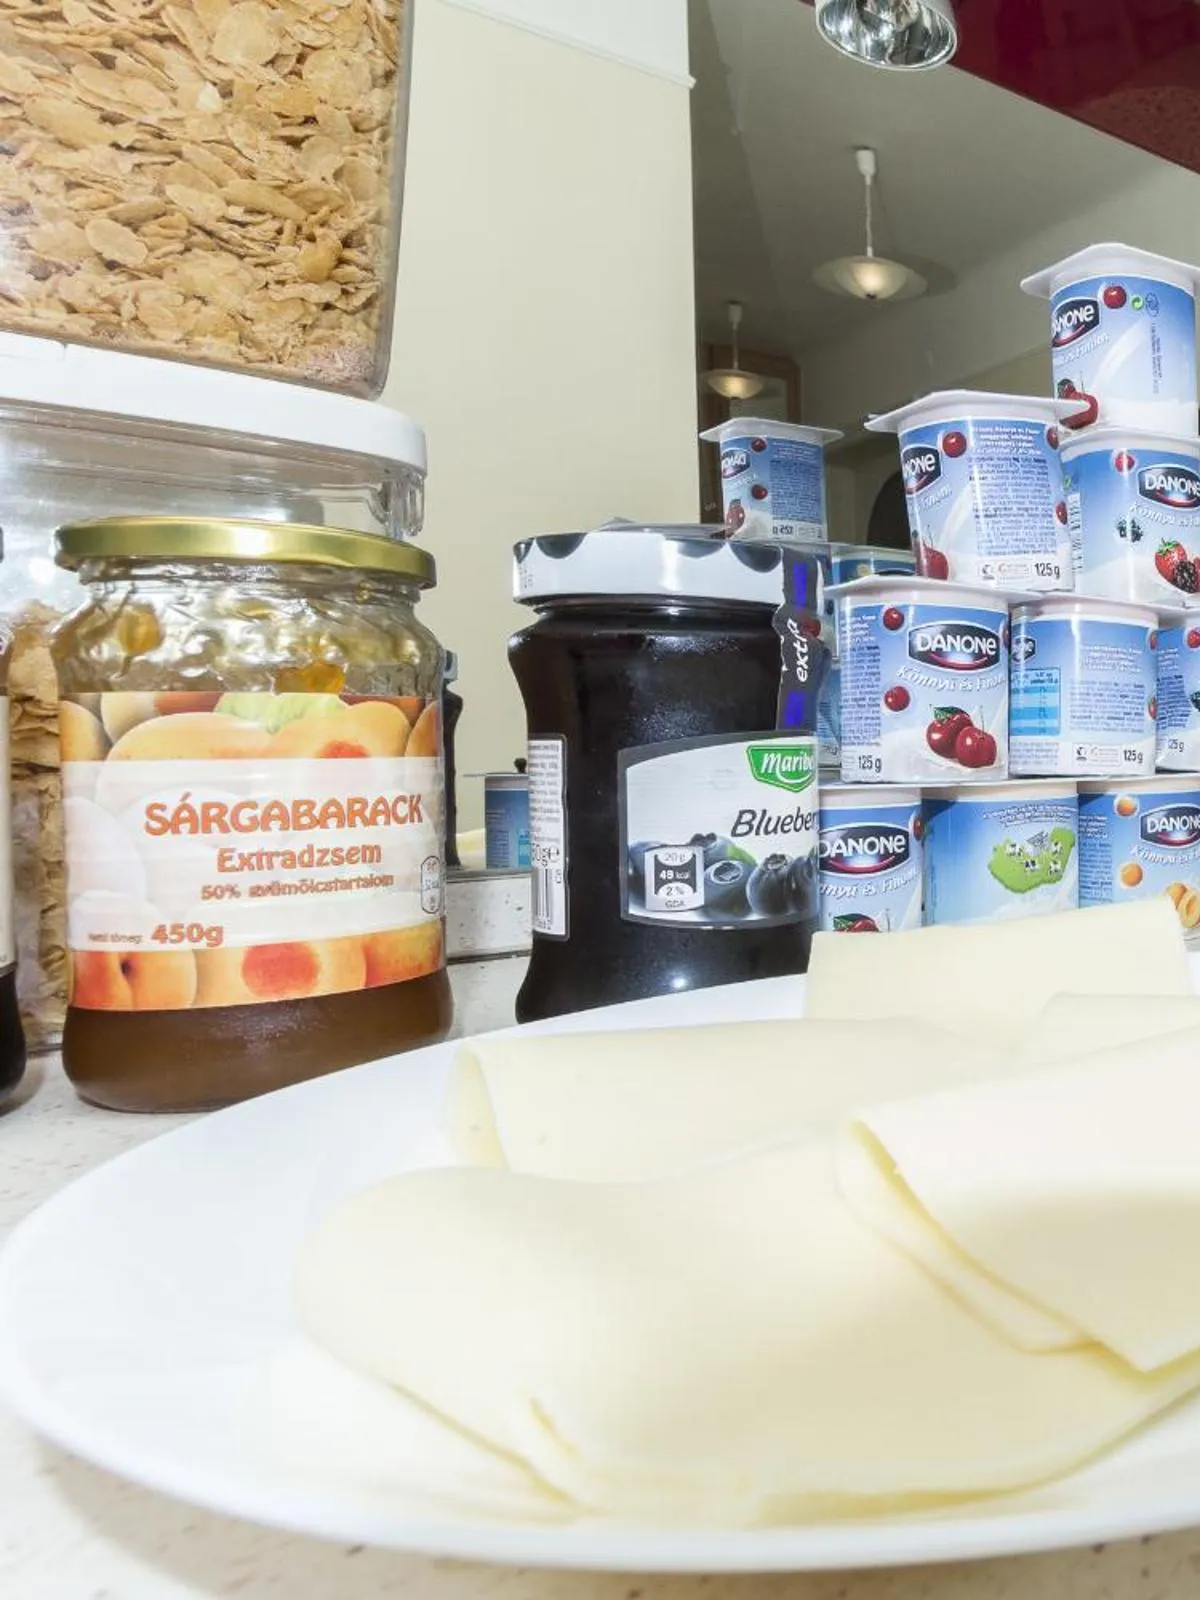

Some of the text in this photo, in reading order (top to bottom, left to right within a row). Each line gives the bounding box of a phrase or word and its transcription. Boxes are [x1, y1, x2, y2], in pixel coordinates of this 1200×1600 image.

[1034, 563, 1053, 577] 125
[1053, 565, 1061, 579] g
[787, 617, 808, 683] extra
[858, 754, 873, 770] 125
[1123, 749, 1137, 763] 125
[145, 791, 423, 836] SÁRGABARACK
[217, 844, 382, 873] Extradzsem
[201, 883, 242, 900] 50%
[151, 923, 224, 948] 450g
